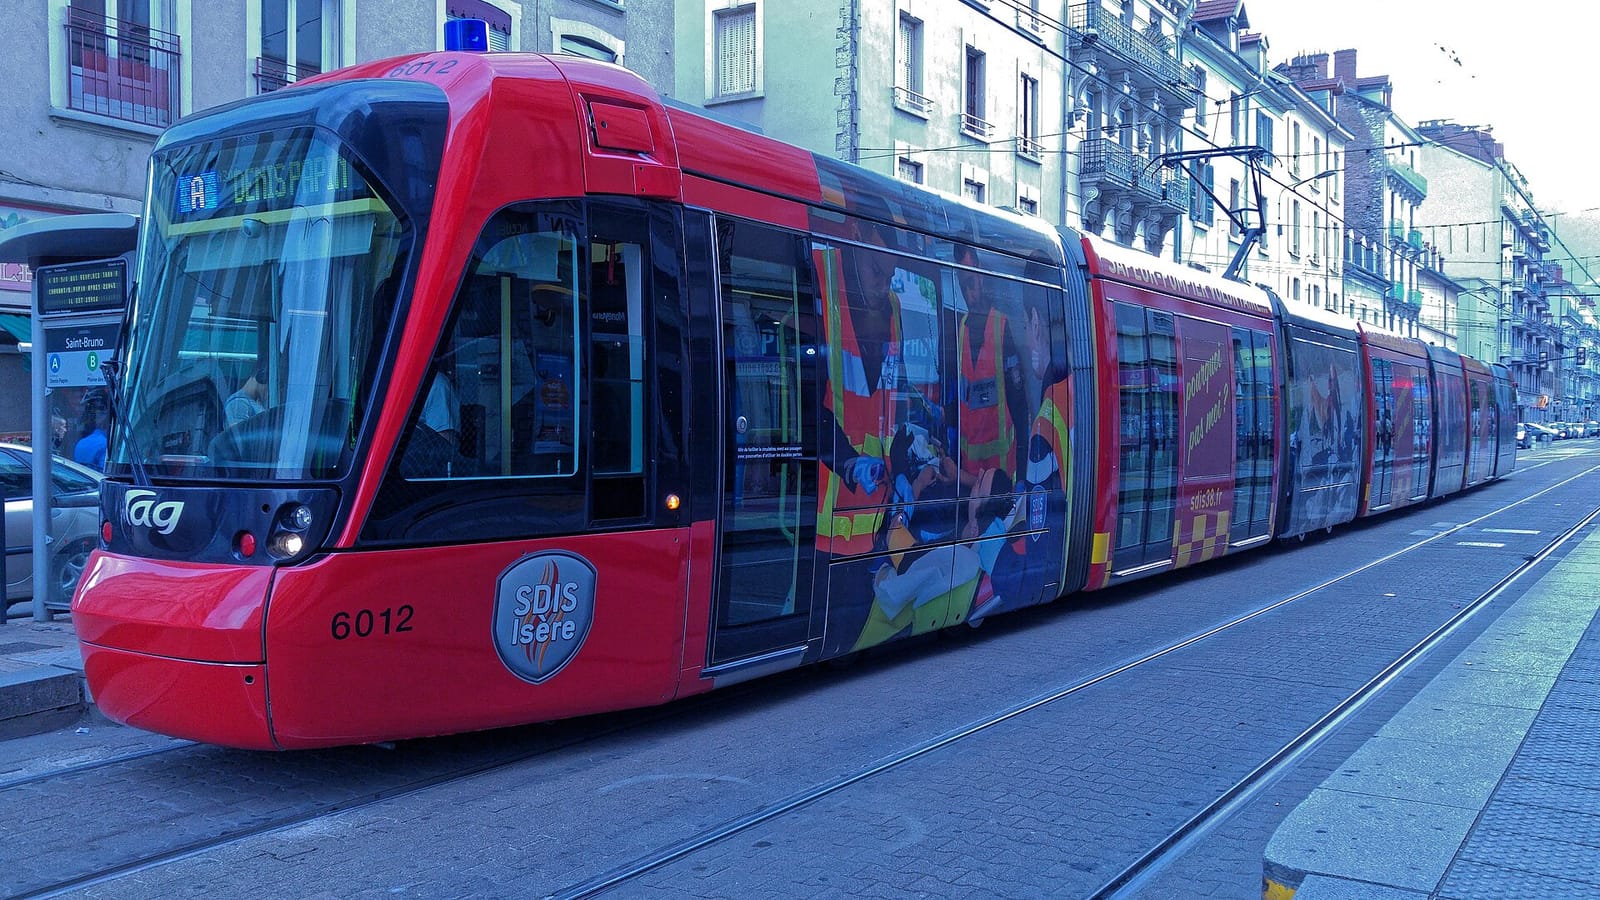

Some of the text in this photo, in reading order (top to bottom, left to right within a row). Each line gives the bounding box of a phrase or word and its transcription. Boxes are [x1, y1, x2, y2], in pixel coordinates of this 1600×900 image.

[389, 59, 458, 78] 6012
[190, 176, 205, 210] A
[65, 336, 104, 349] Saint-Bruno
[51, 355, 96, 369] A B
[1187, 417, 1204, 465] pas
[1206, 391, 1221, 434] moi
[1190, 489, 1223, 511] sdis38.fr
[513, 582, 579, 617] SDIS
[331, 604, 415, 640] 6012
[511, 617, 577, 645] Isère
